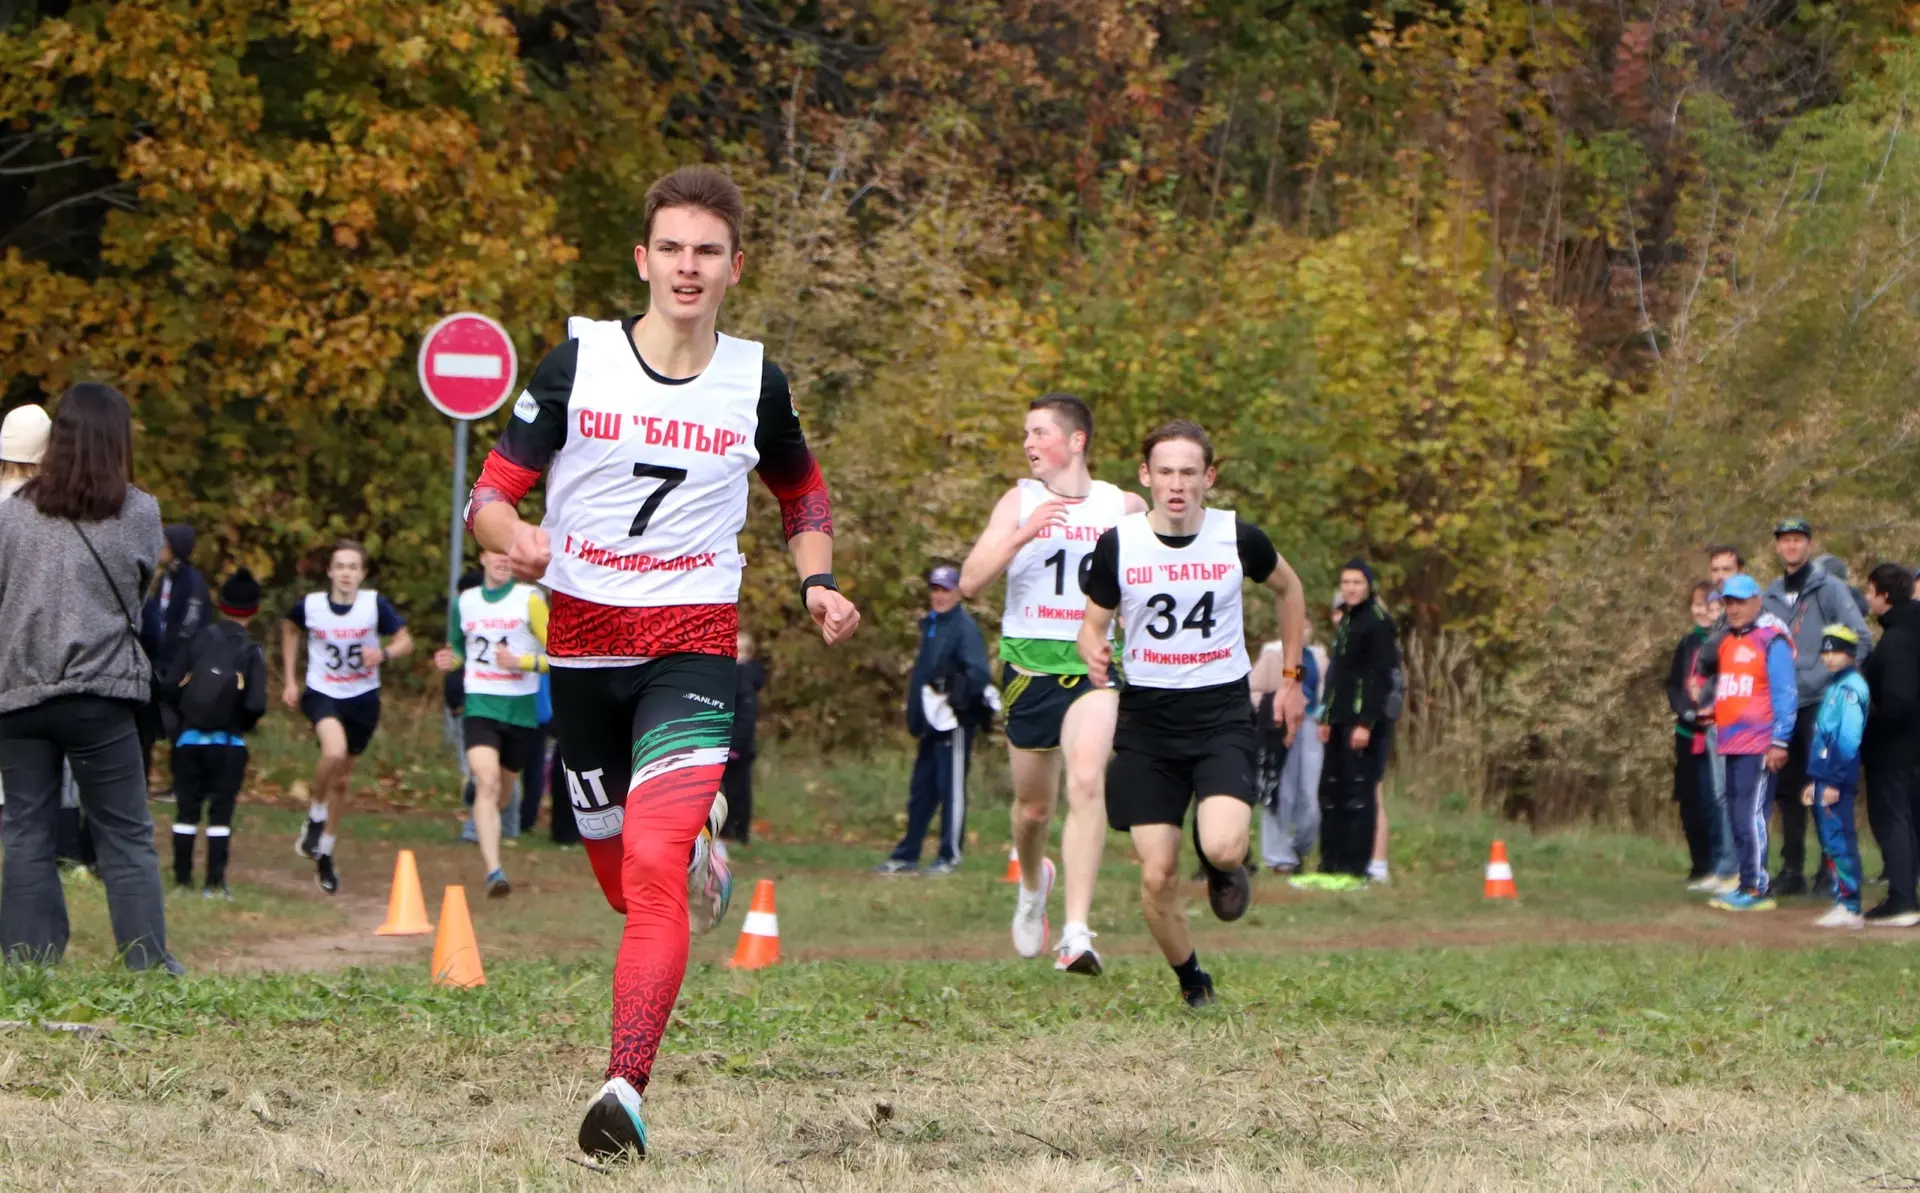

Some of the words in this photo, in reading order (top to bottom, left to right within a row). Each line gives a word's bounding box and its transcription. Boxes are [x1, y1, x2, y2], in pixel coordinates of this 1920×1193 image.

[579, 408, 622, 441] СШ
[632, 415, 747, 457] "БАТЫР"
[628, 462, 688, 538] 7
[1126, 565, 1154, 586] СШ
[1157, 562, 1236, 582] "БАТЫР"
[1145, 590, 1217, 641] 34
[325, 643, 364, 671] 35
[1143, 646, 1233, 666] Нижнекамск
